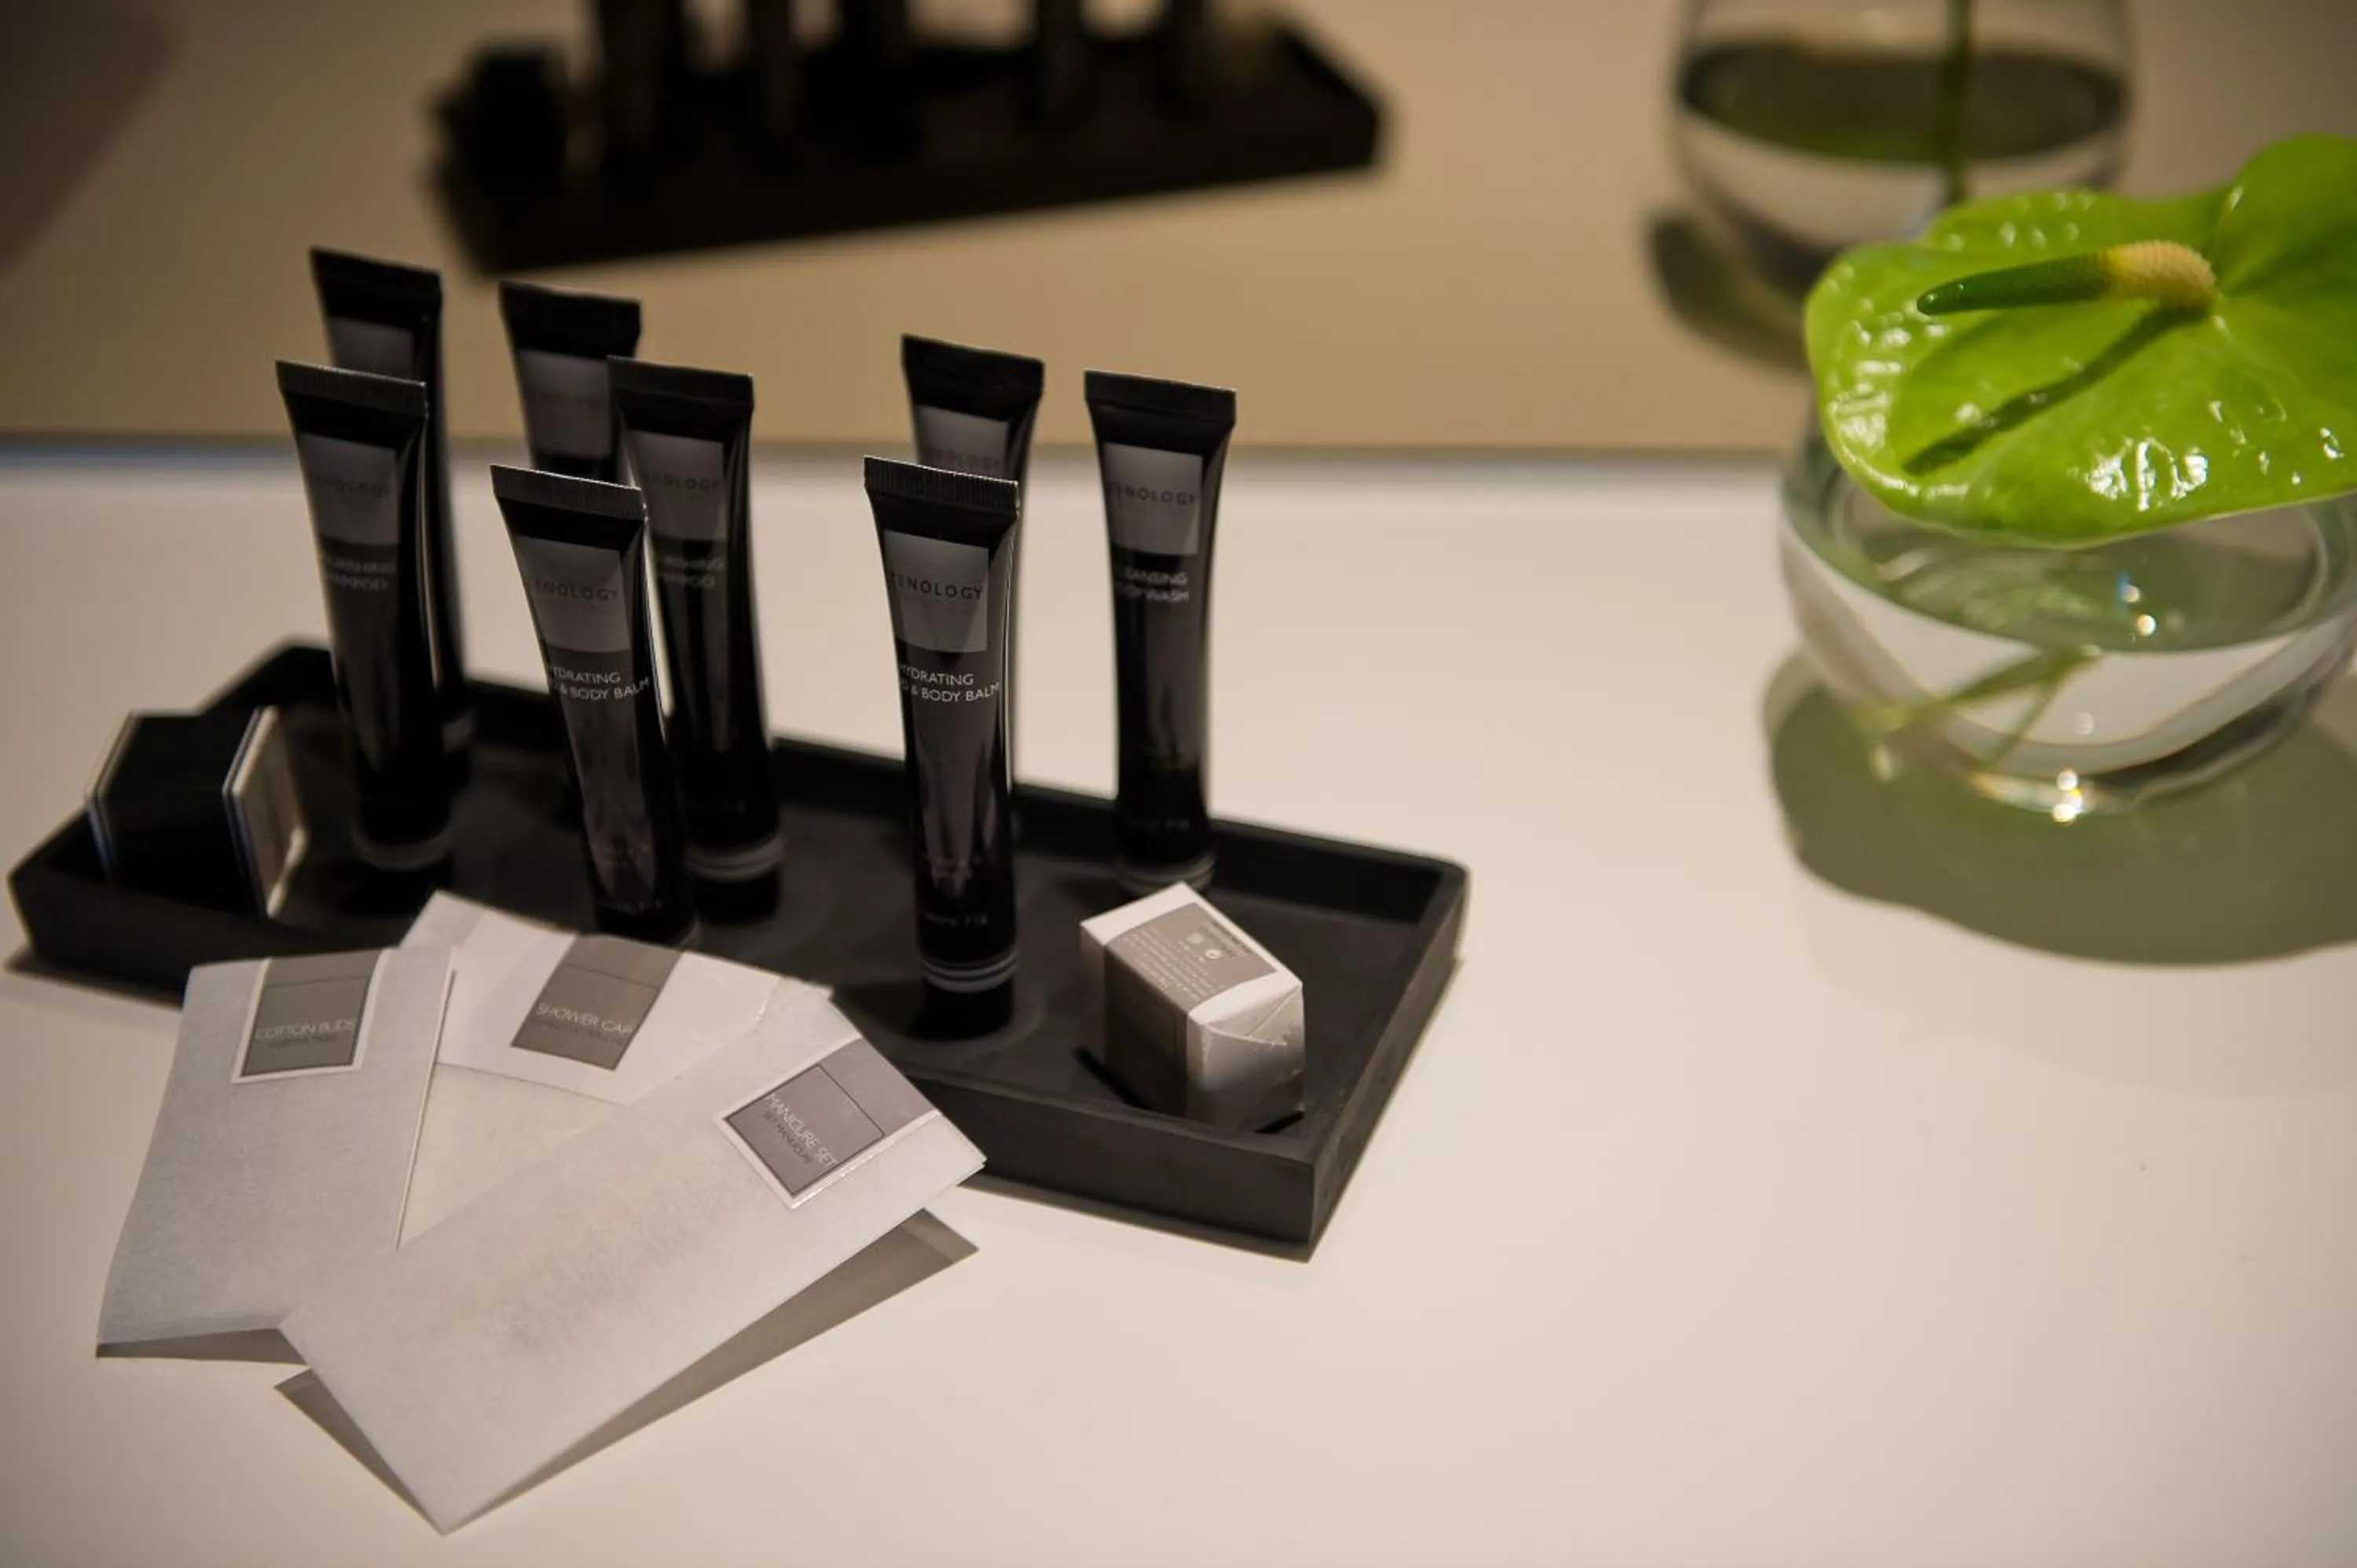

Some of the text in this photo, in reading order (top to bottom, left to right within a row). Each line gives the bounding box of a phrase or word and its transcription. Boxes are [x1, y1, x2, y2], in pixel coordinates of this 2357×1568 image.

[551, 665, 622, 686] YDRATING
[570, 686, 609, 702] BODY
[613, 676, 651, 701] BALM
[920, 686, 961, 703] BODY
[964, 681, 1001, 703] BALM
[600, 1020, 633, 1039] CAP
[763, 1093, 838, 1168] MANICURE SET
